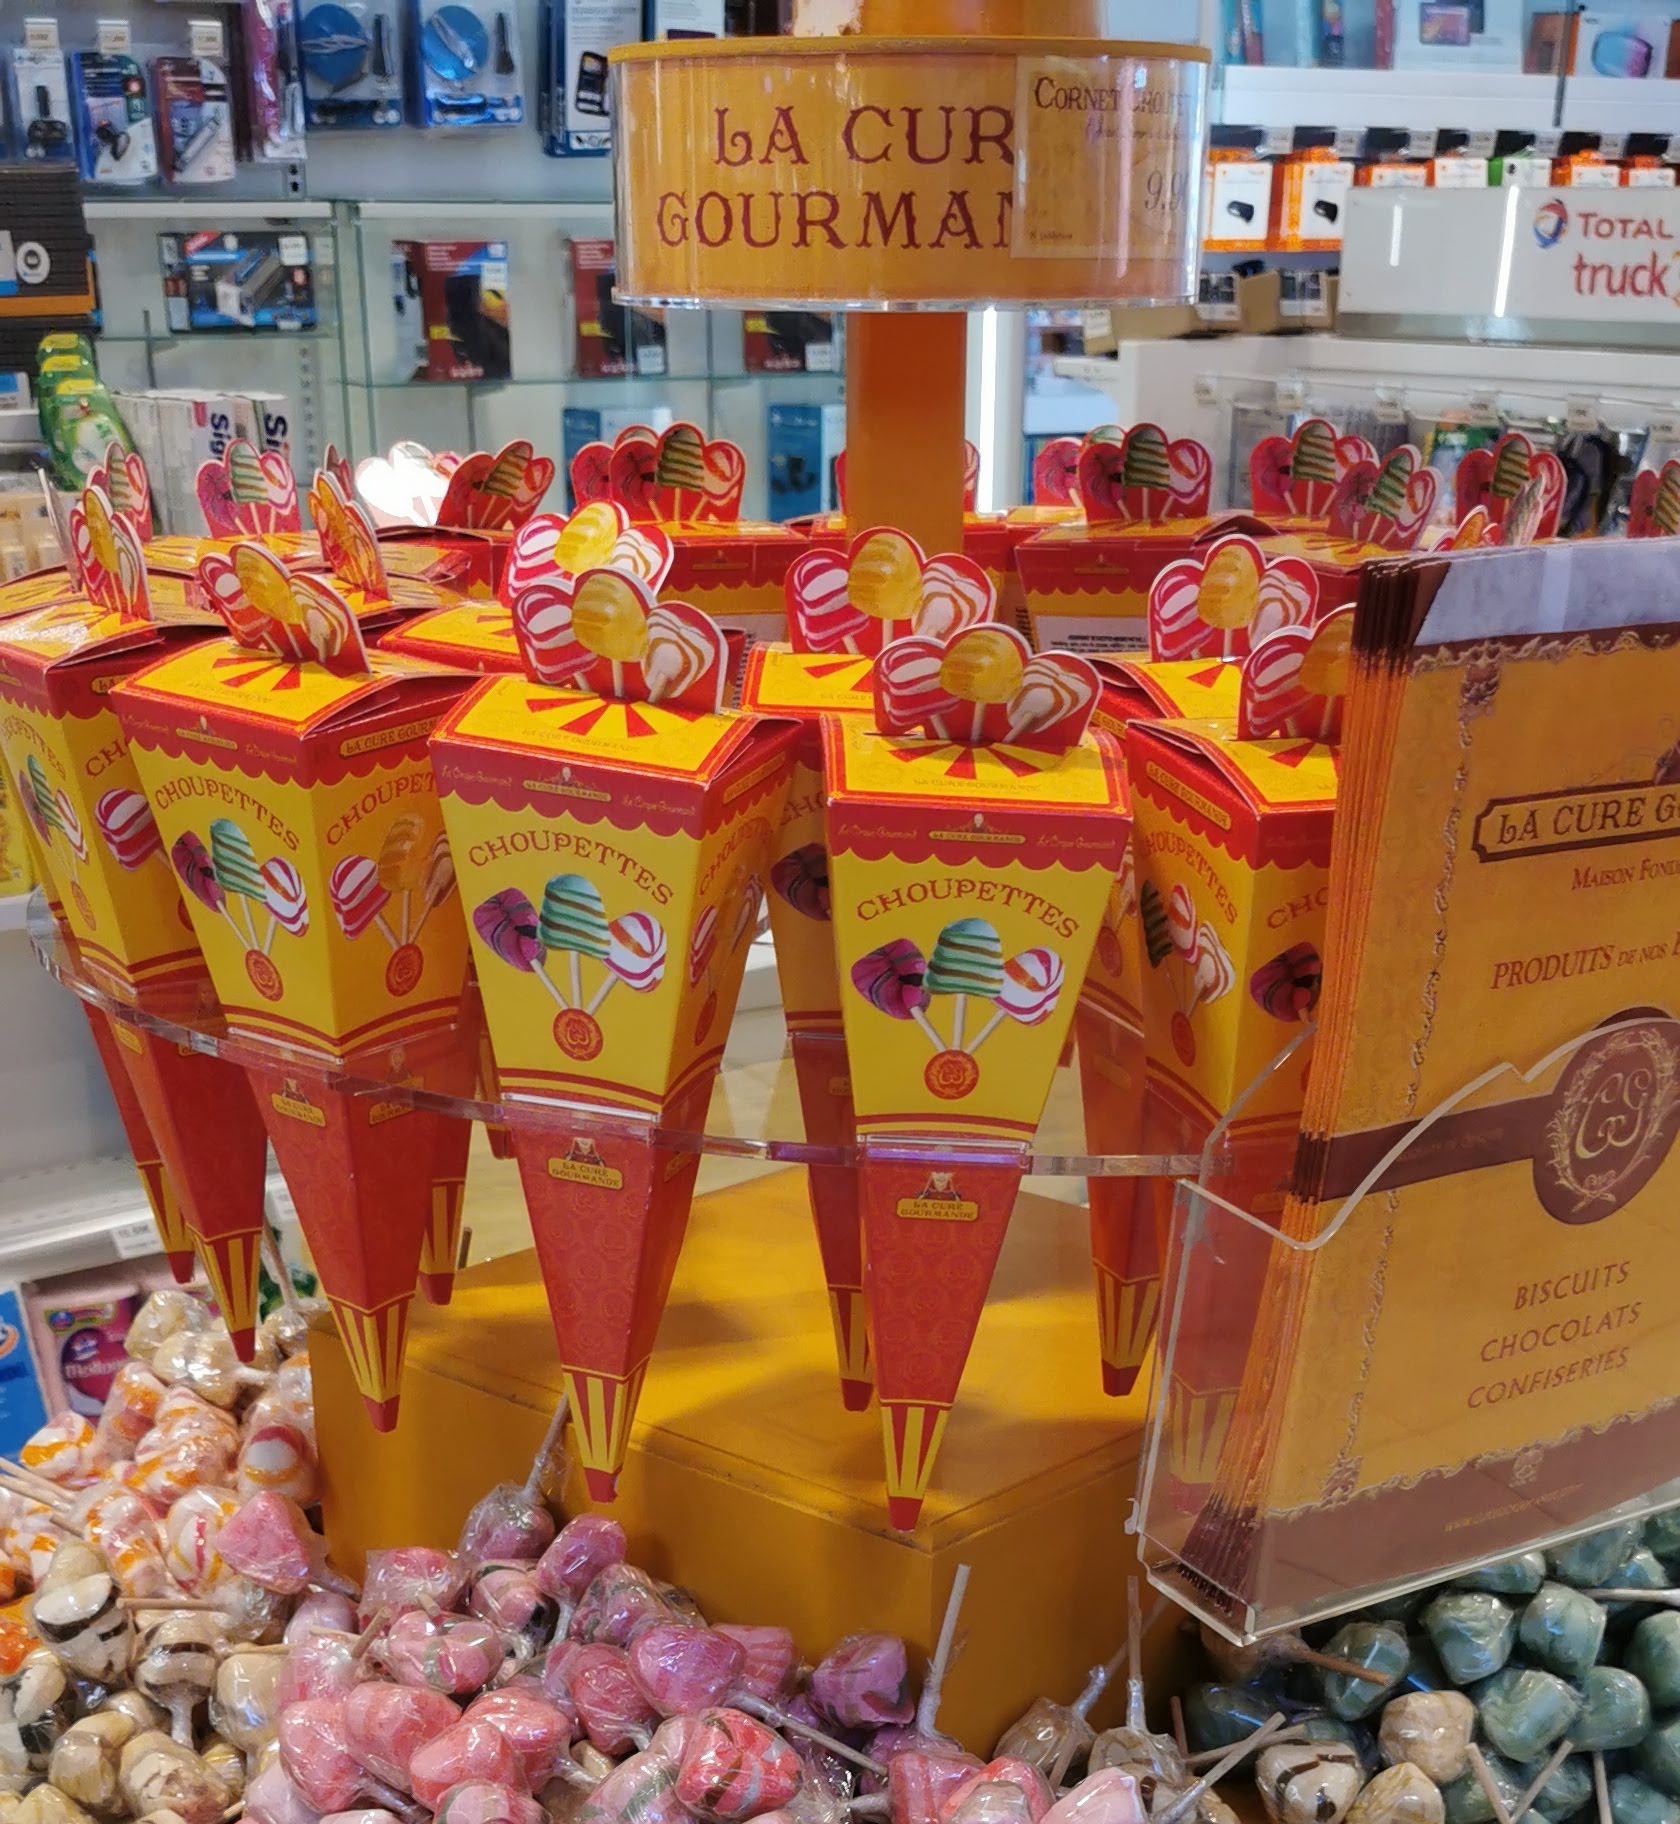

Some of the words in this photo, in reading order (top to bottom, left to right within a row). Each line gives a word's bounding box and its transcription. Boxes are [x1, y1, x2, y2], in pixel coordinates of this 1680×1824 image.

[714, 105, 809, 166] LA
[1577, 211, 1674, 239] TOTAL
[1573, 249, 1671, 297] truck
[264, 413, 288, 454] Si
[154, 774, 300, 852] CHOUPETTES
[1497, 809, 1540, 845] LA
[1552, 797, 1647, 836] CURE
[1655, 793, 1680, 824] G
[468, 830, 674, 906] CHOUPETTES
[856, 878, 1080, 939] CHOUPETTES
[1490, 944, 1615, 989] PRODUITS
[1513, 1260, 1632, 1311] BISCUITS
[1480, 1301, 1643, 1363] CHOCOLATS
[1466, 1346, 1630, 1409] CONFISERIES
